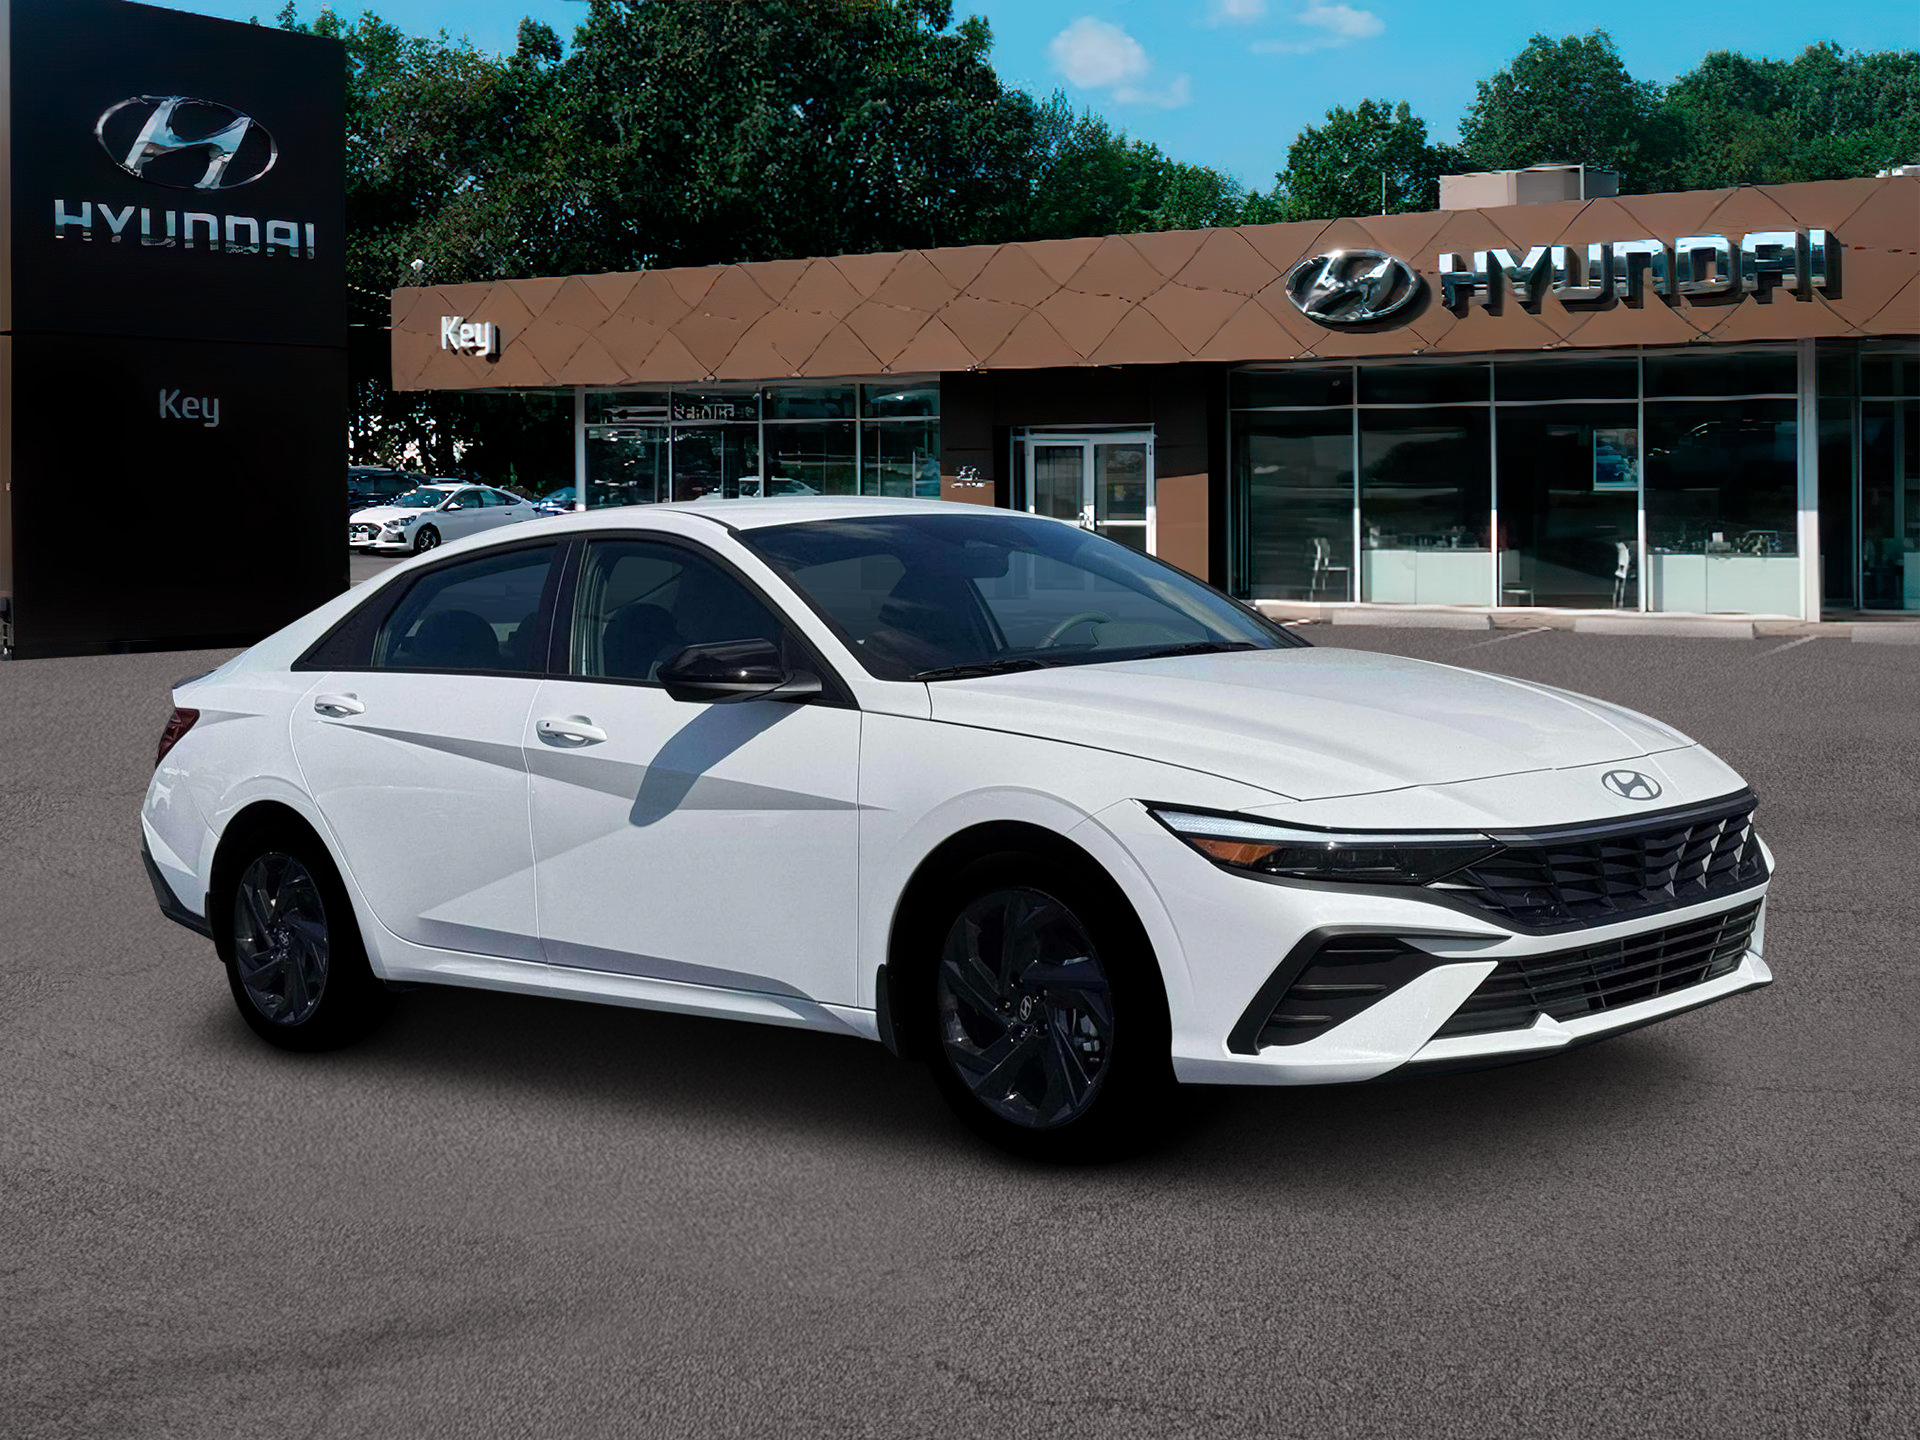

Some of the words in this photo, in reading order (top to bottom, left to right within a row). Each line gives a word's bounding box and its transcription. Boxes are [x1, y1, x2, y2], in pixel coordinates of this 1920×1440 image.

[54, 199, 315, 260] HYUNDAI
[1438, 228, 1836, 313] HYUNDAI
[441, 316, 492, 357] Key
[159, 388, 220, 428] Key
